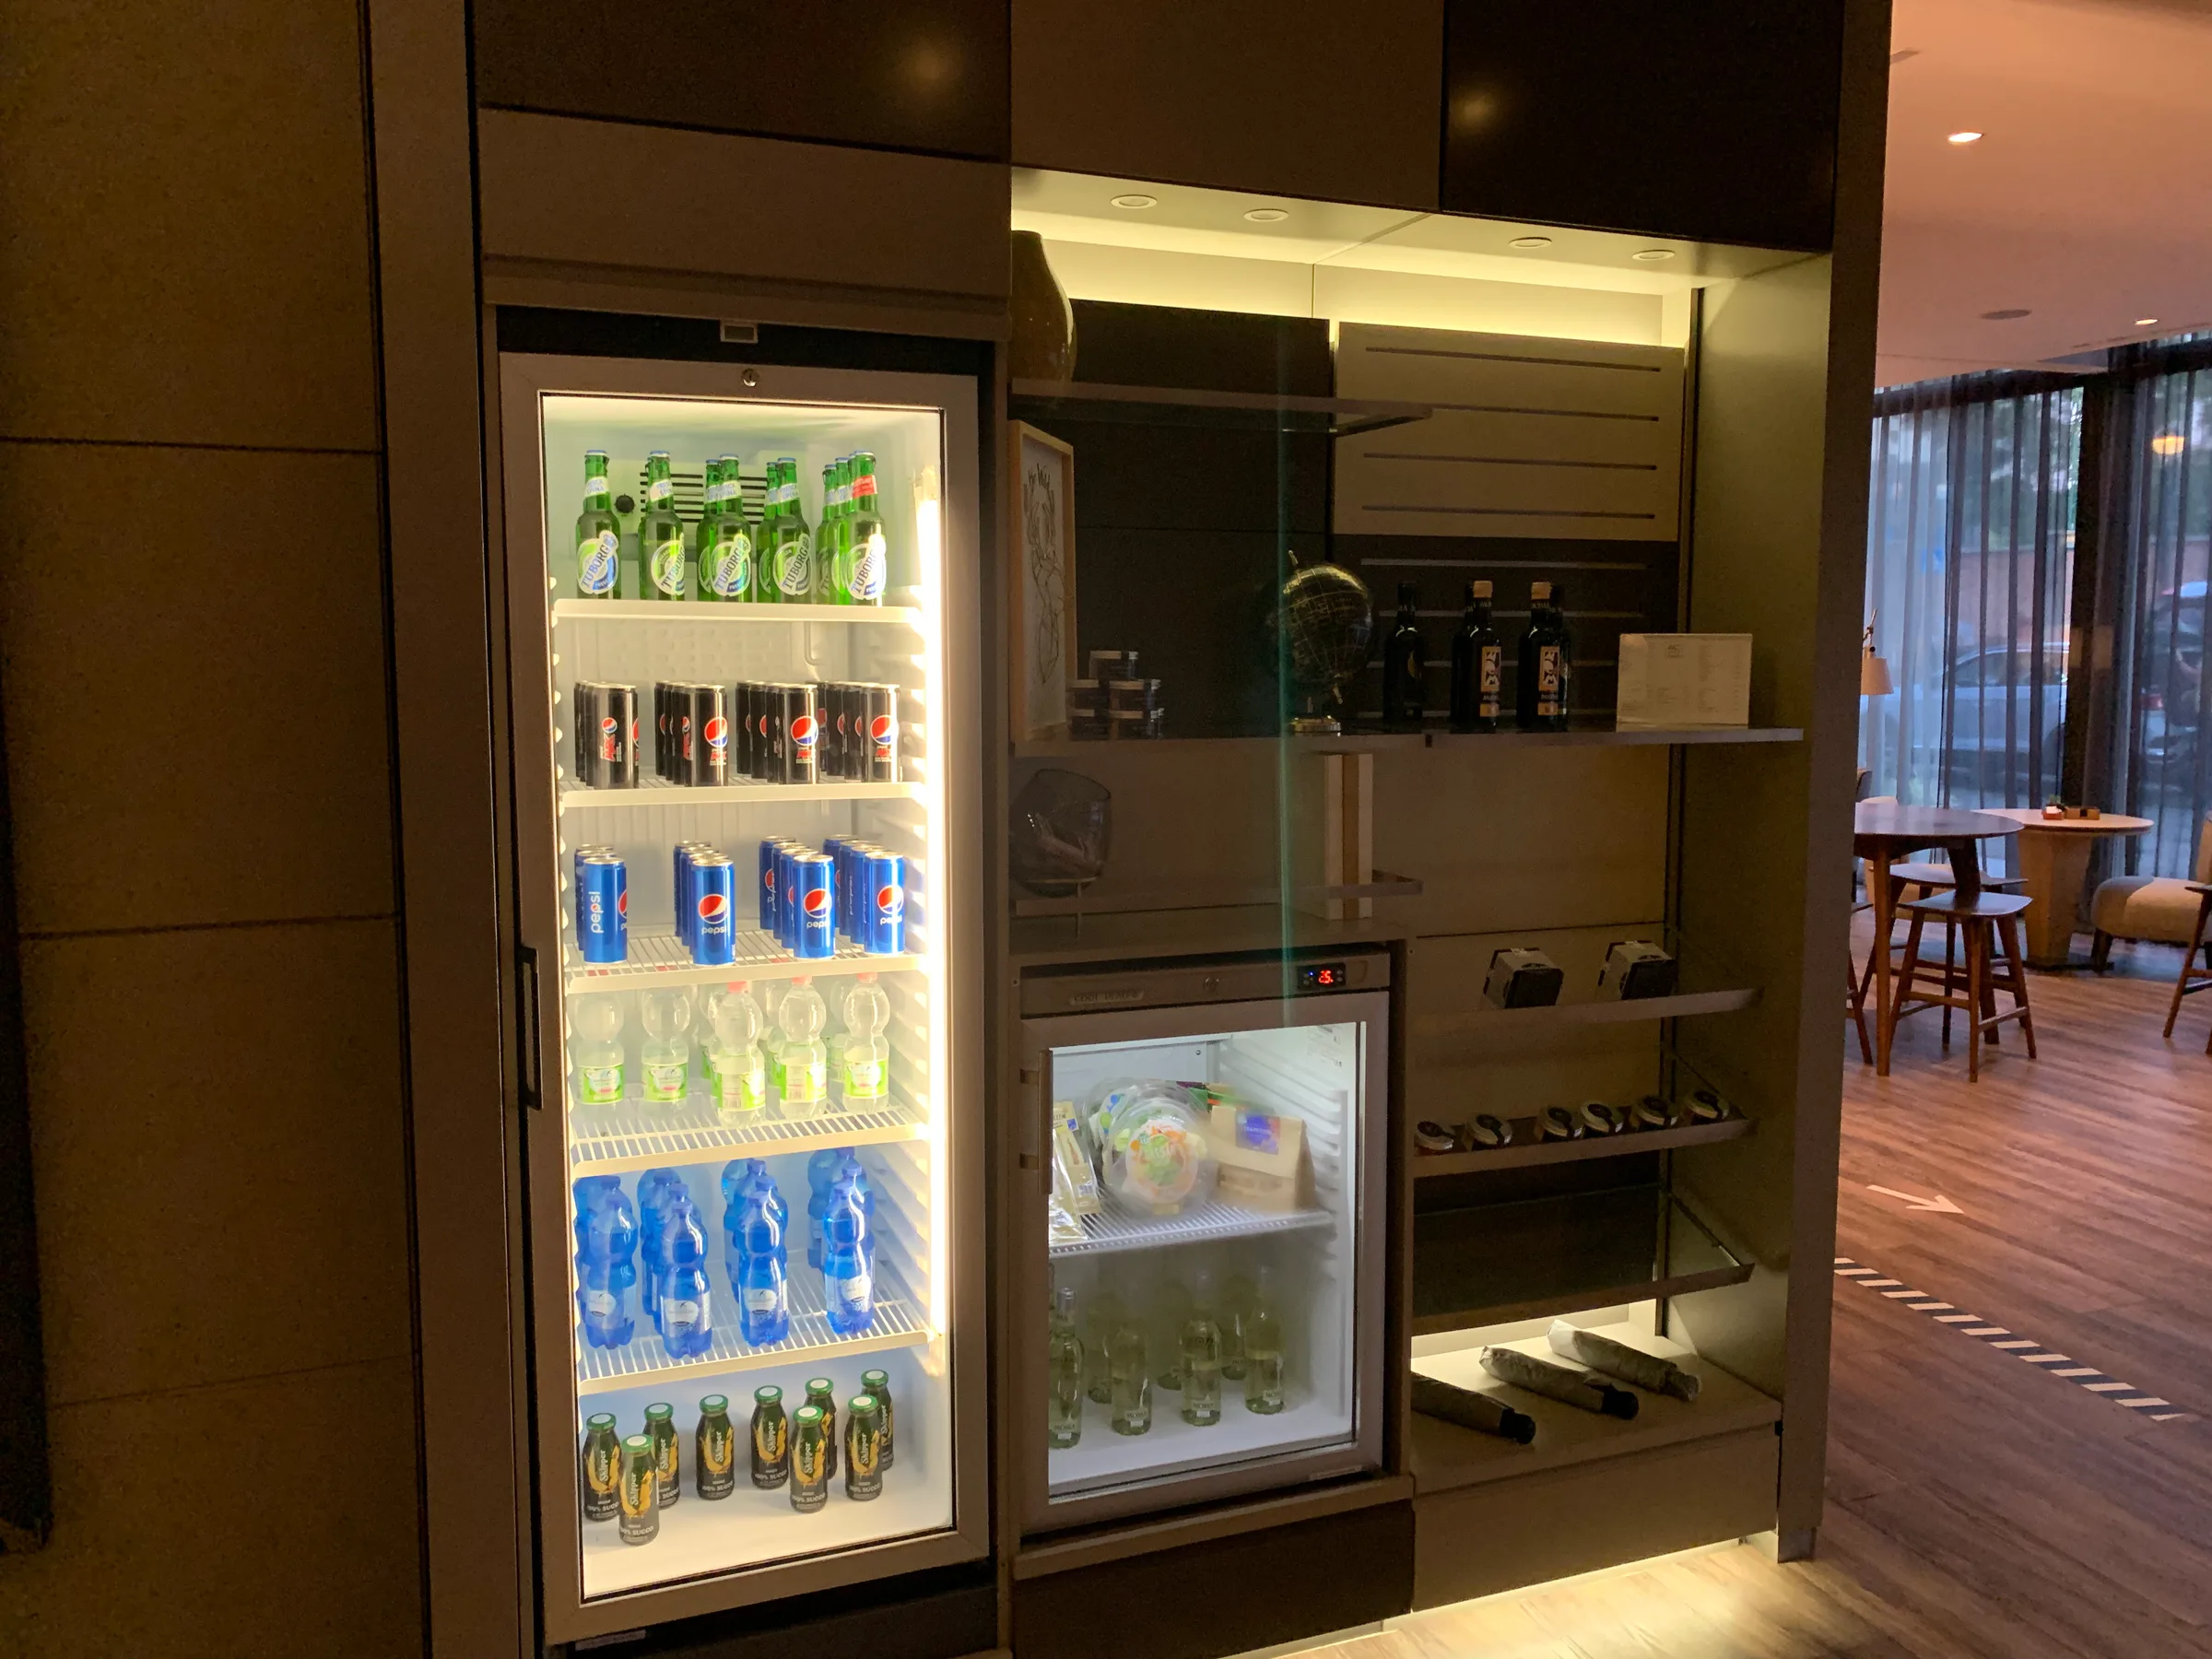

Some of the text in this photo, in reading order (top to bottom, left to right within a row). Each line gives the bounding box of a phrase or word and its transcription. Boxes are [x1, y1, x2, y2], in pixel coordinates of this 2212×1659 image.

[581, 544, 611, 588] TUBORG
[713, 547, 741, 590] TUBORG
[782, 545, 808, 590] TUBORG
[589, 891, 604, 934] pepsi
[701, 925, 726, 935] pepsi
[715, 1431, 724, 1463] Skipper
[767, 1421, 776, 1452] Skipper
[861, 1432, 869, 1464] Skipper
[600, 1450, 609, 1481] Skipper
[659, 1438, 669, 1470] Skipper
[805, 1441, 813, 1474] Skipper
[629, 1473, 639, 1506] Skipper
